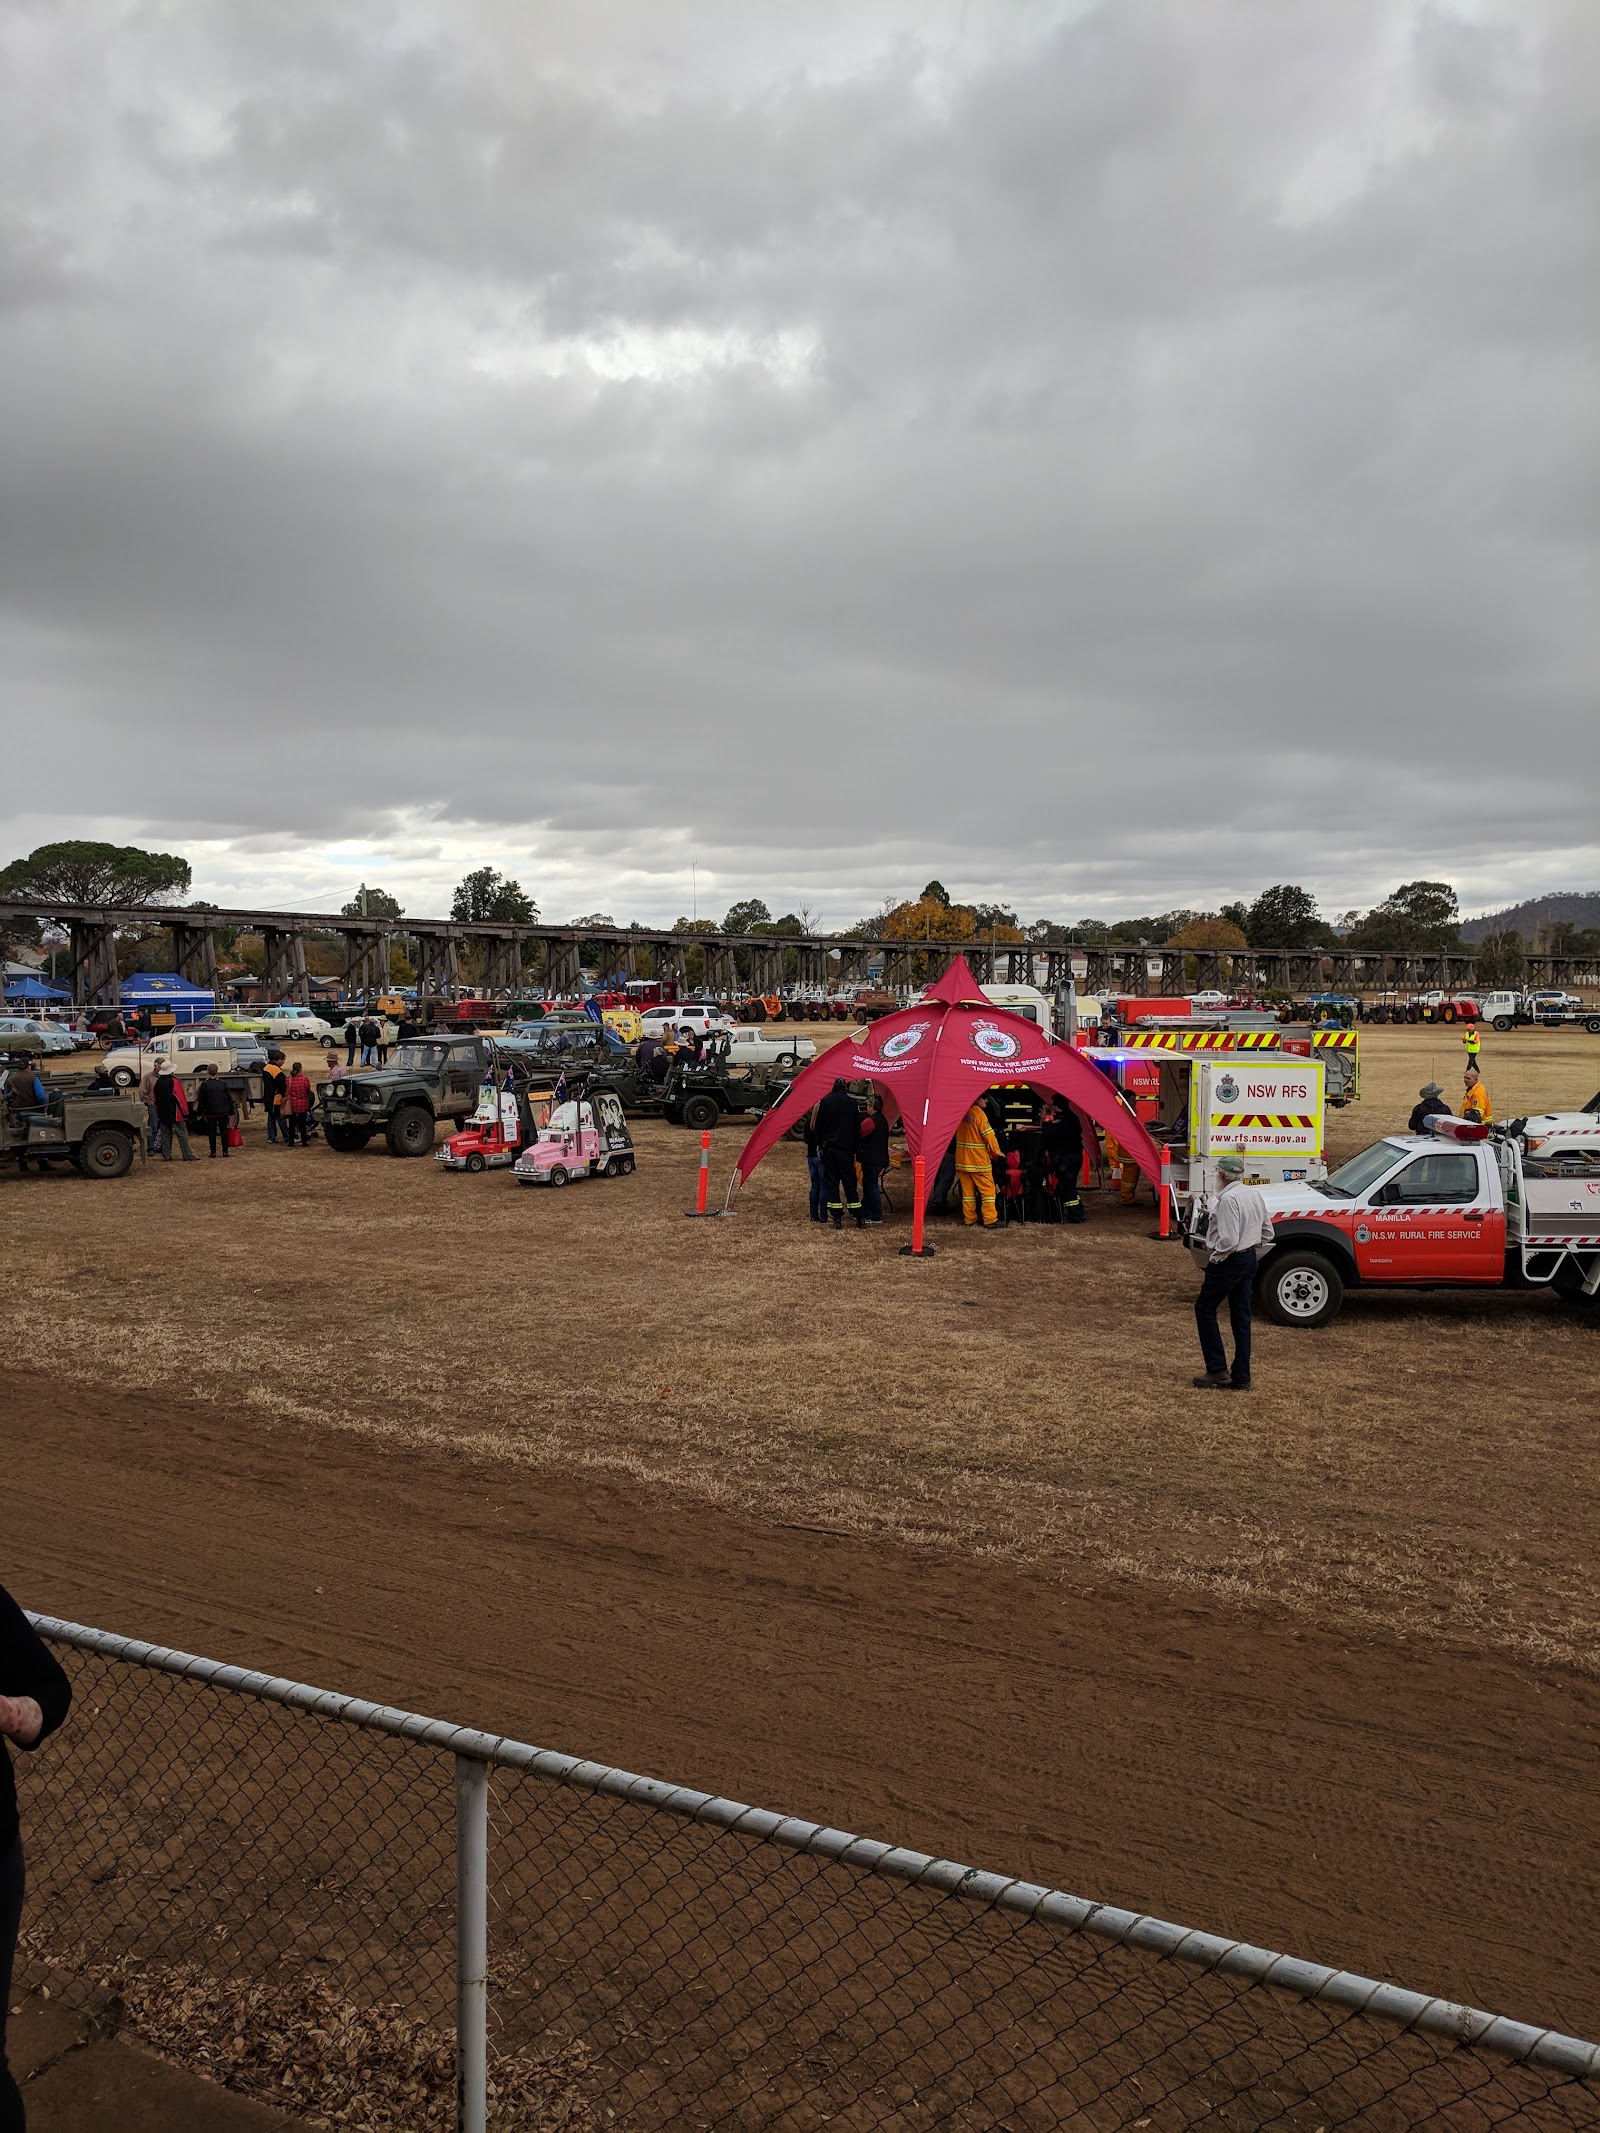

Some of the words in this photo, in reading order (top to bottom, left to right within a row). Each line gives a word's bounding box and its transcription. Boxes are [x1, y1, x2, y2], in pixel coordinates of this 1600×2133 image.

[894, 1058, 919, 1067] SERVICE
[979, 1060, 1004, 1068] RURAL
[1021, 1057, 1051, 1066] SERVICE
[971, 1066, 1014, 1074] TAMWORTH
[1015, 1064, 1046, 1073] DISTRICT
[1132, 1078, 1150, 1086] NSW
[1247, 1084, 1277, 1098] NSW
[1282, 1085, 1307, 1098] RFS
[1375, 1214, 1411, 1222] MANILLA
[1371, 1232, 1397, 1240] N.S.W.
[1400, 1231, 1426, 1239] RURAL
[1428, 1231, 1445, 1239] FIRE
[1447, 1230, 1481, 1239] SERVICE
